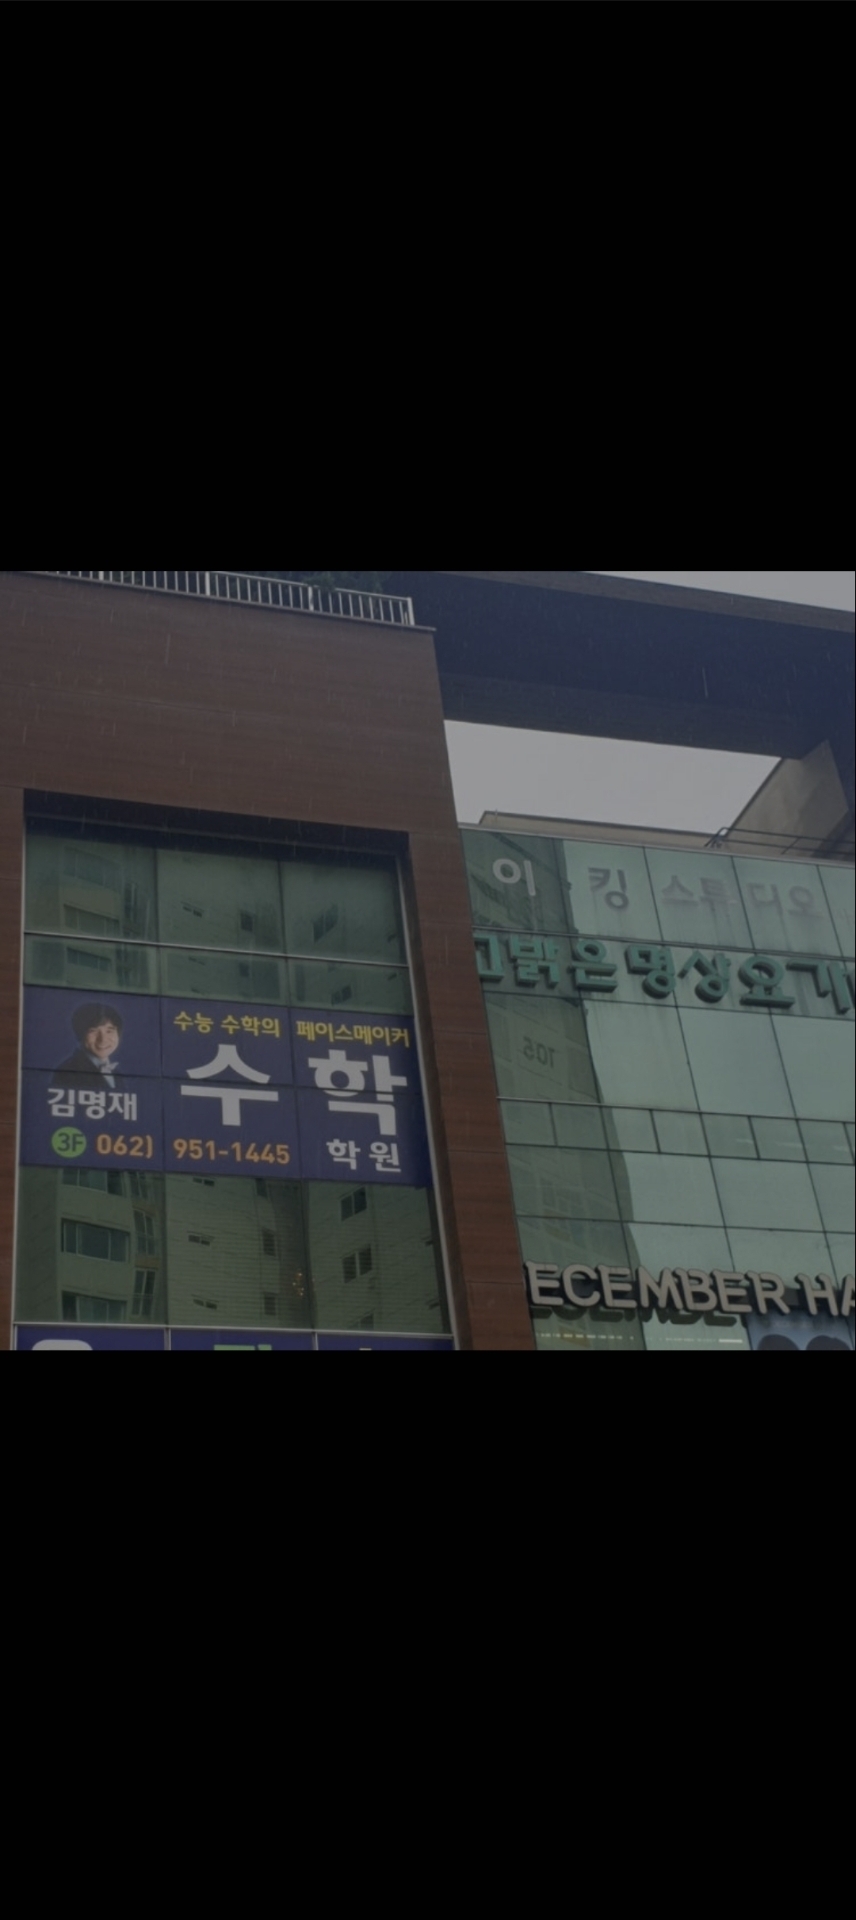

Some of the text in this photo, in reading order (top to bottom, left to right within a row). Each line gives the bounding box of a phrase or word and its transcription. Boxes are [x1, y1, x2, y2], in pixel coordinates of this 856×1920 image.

[173, 1011, 410, 1047] 수능 수학의 페이스메이커
[47, 1088, 138, 1121] 김명재
[57, 1131, 290, 1164] 3F 062) 951-1445
[525, 1261, 791, 1315] ECEMBER
